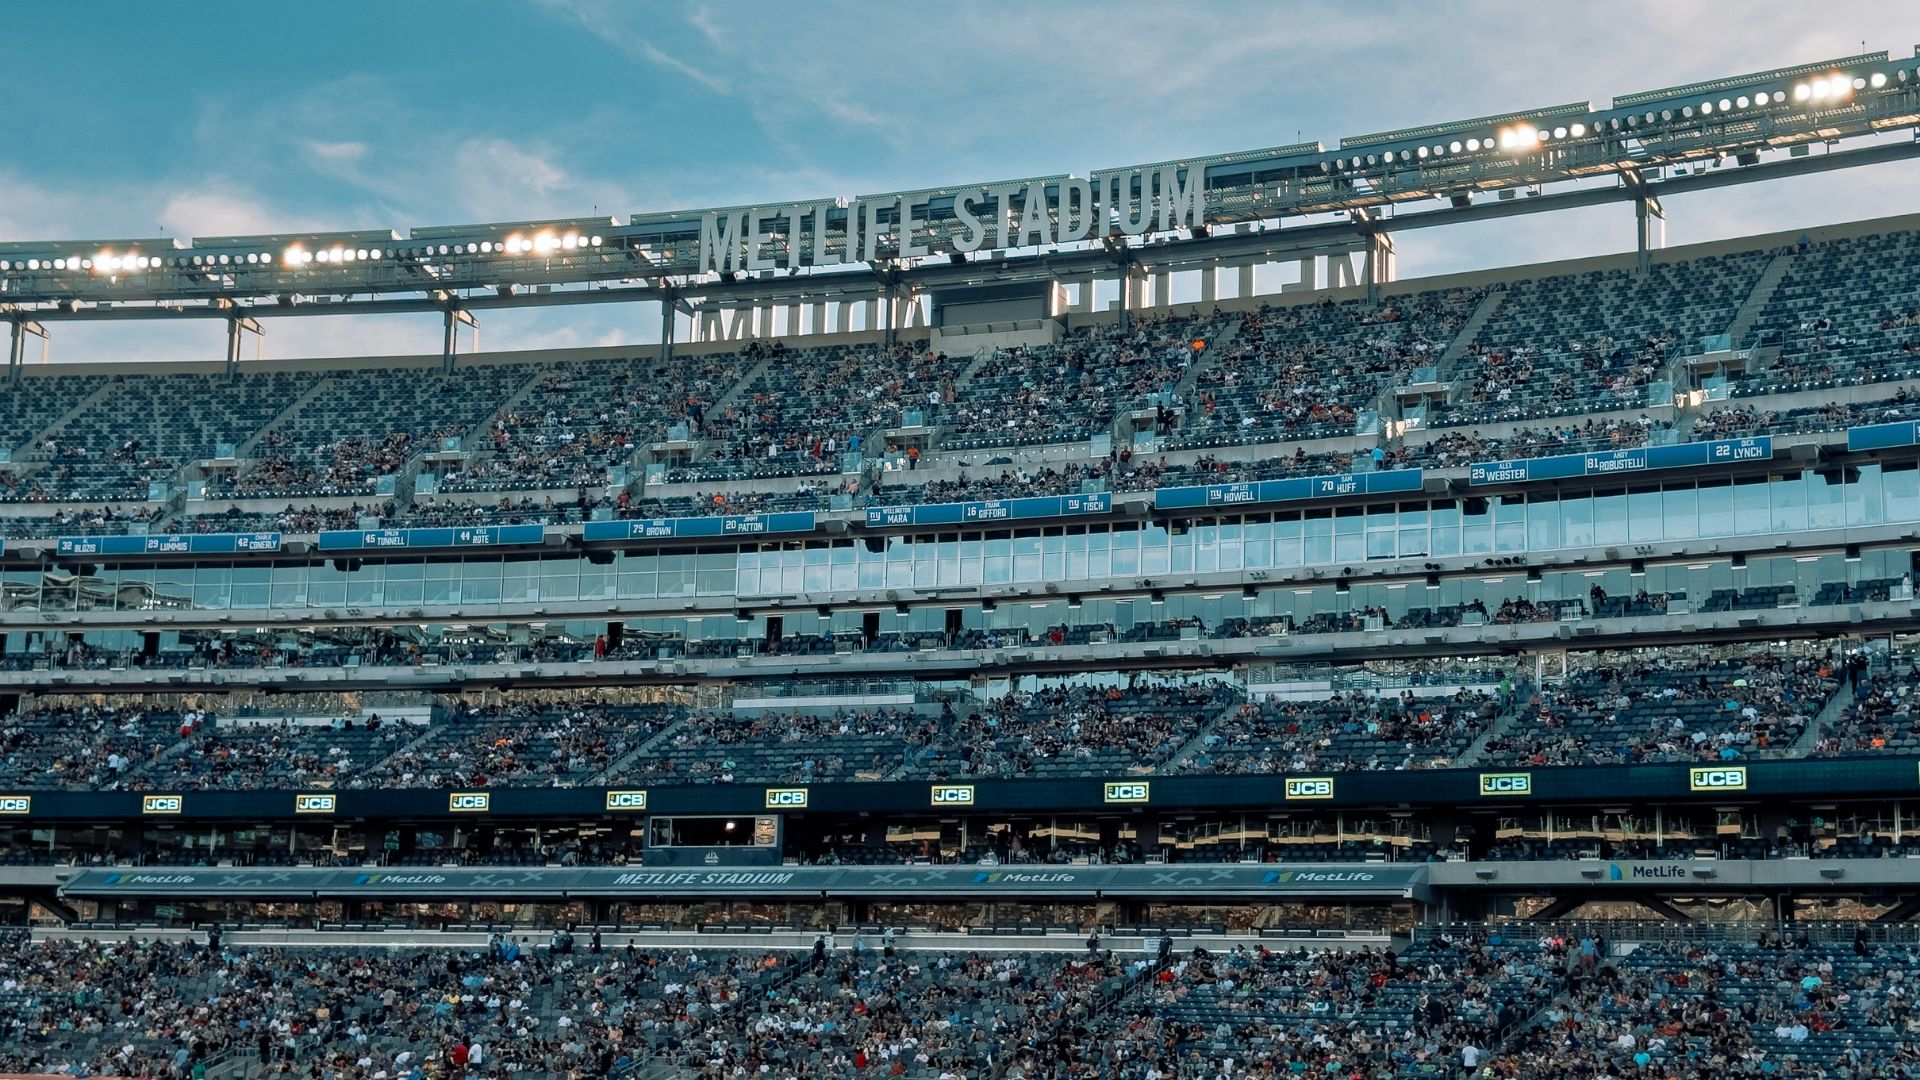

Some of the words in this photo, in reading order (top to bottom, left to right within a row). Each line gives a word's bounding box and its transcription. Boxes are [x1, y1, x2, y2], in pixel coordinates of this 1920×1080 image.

[699, 194, 930, 274] METLIFE
[952, 162, 1206, 253] STADIUM
[1716, 445, 1730, 457] 22
[1734, 447, 1762, 459] LYNCH
[1498, 462, 1512, 470] ALEX
[1587, 458, 1599, 469] 81
[1599, 458, 1644, 472] ROBUSTELLI
[1472, 468, 1485, 479] 29
[1486, 468, 1525, 482] WEBSTER
[1321, 481, 1334, 491] 70
[1337, 483, 1356, 493] HUFF
[1224, 491, 1254, 502] HOWELL
[1083, 501, 1104, 511] TISCH
[887, 514, 908, 524] MARA
[967, 507, 976, 516] 16
[978, 508, 1007, 519] GIFFORD
[633, 524, 644, 534] 79
[646, 527, 671, 536] BROWN
[725, 520, 737, 529] 20
[738, 523, 763, 532] PATTON
[365, 534, 376, 543] 45
[377, 535, 405, 546] TUNNELL
[460, 531, 470, 540] 44
[472, 535, 490, 544] ROTE
[61, 541, 73, 550] 32
[74, 544, 97, 553] BLOZIS
[148, 540, 159, 548] 29
[159, 542, 188, 551] LUMMUS
[237, 538, 249, 547] 42
[249, 540, 278, 550] CONERLY
[1484, 778, 1527, 791] JCB
[1694, 771, 1743, 786] JCB
[1108, 786, 1146, 798] JCB
[1289, 782, 1330, 795] JCB
[609, 795, 644, 806] JCB
[769, 792, 805, 804] JCB
[934, 789, 971, 801] JCB
[146, 799, 179, 810] JCB
[299, 798, 333, 809] JCB
[453, 796, 487, 807] JCB
[1003, 873, 1075, 882] MetLife
[1295, 872, 1374, 881] MetLife
[1633, 865, 1686, 878] MetLife
[131, 875, 195, 884] MetLife
[381, 875, 446, 884] MetLife
[613, 873, 701, 884] METLIFE
[701, 872, 794, 884] STADIUM
